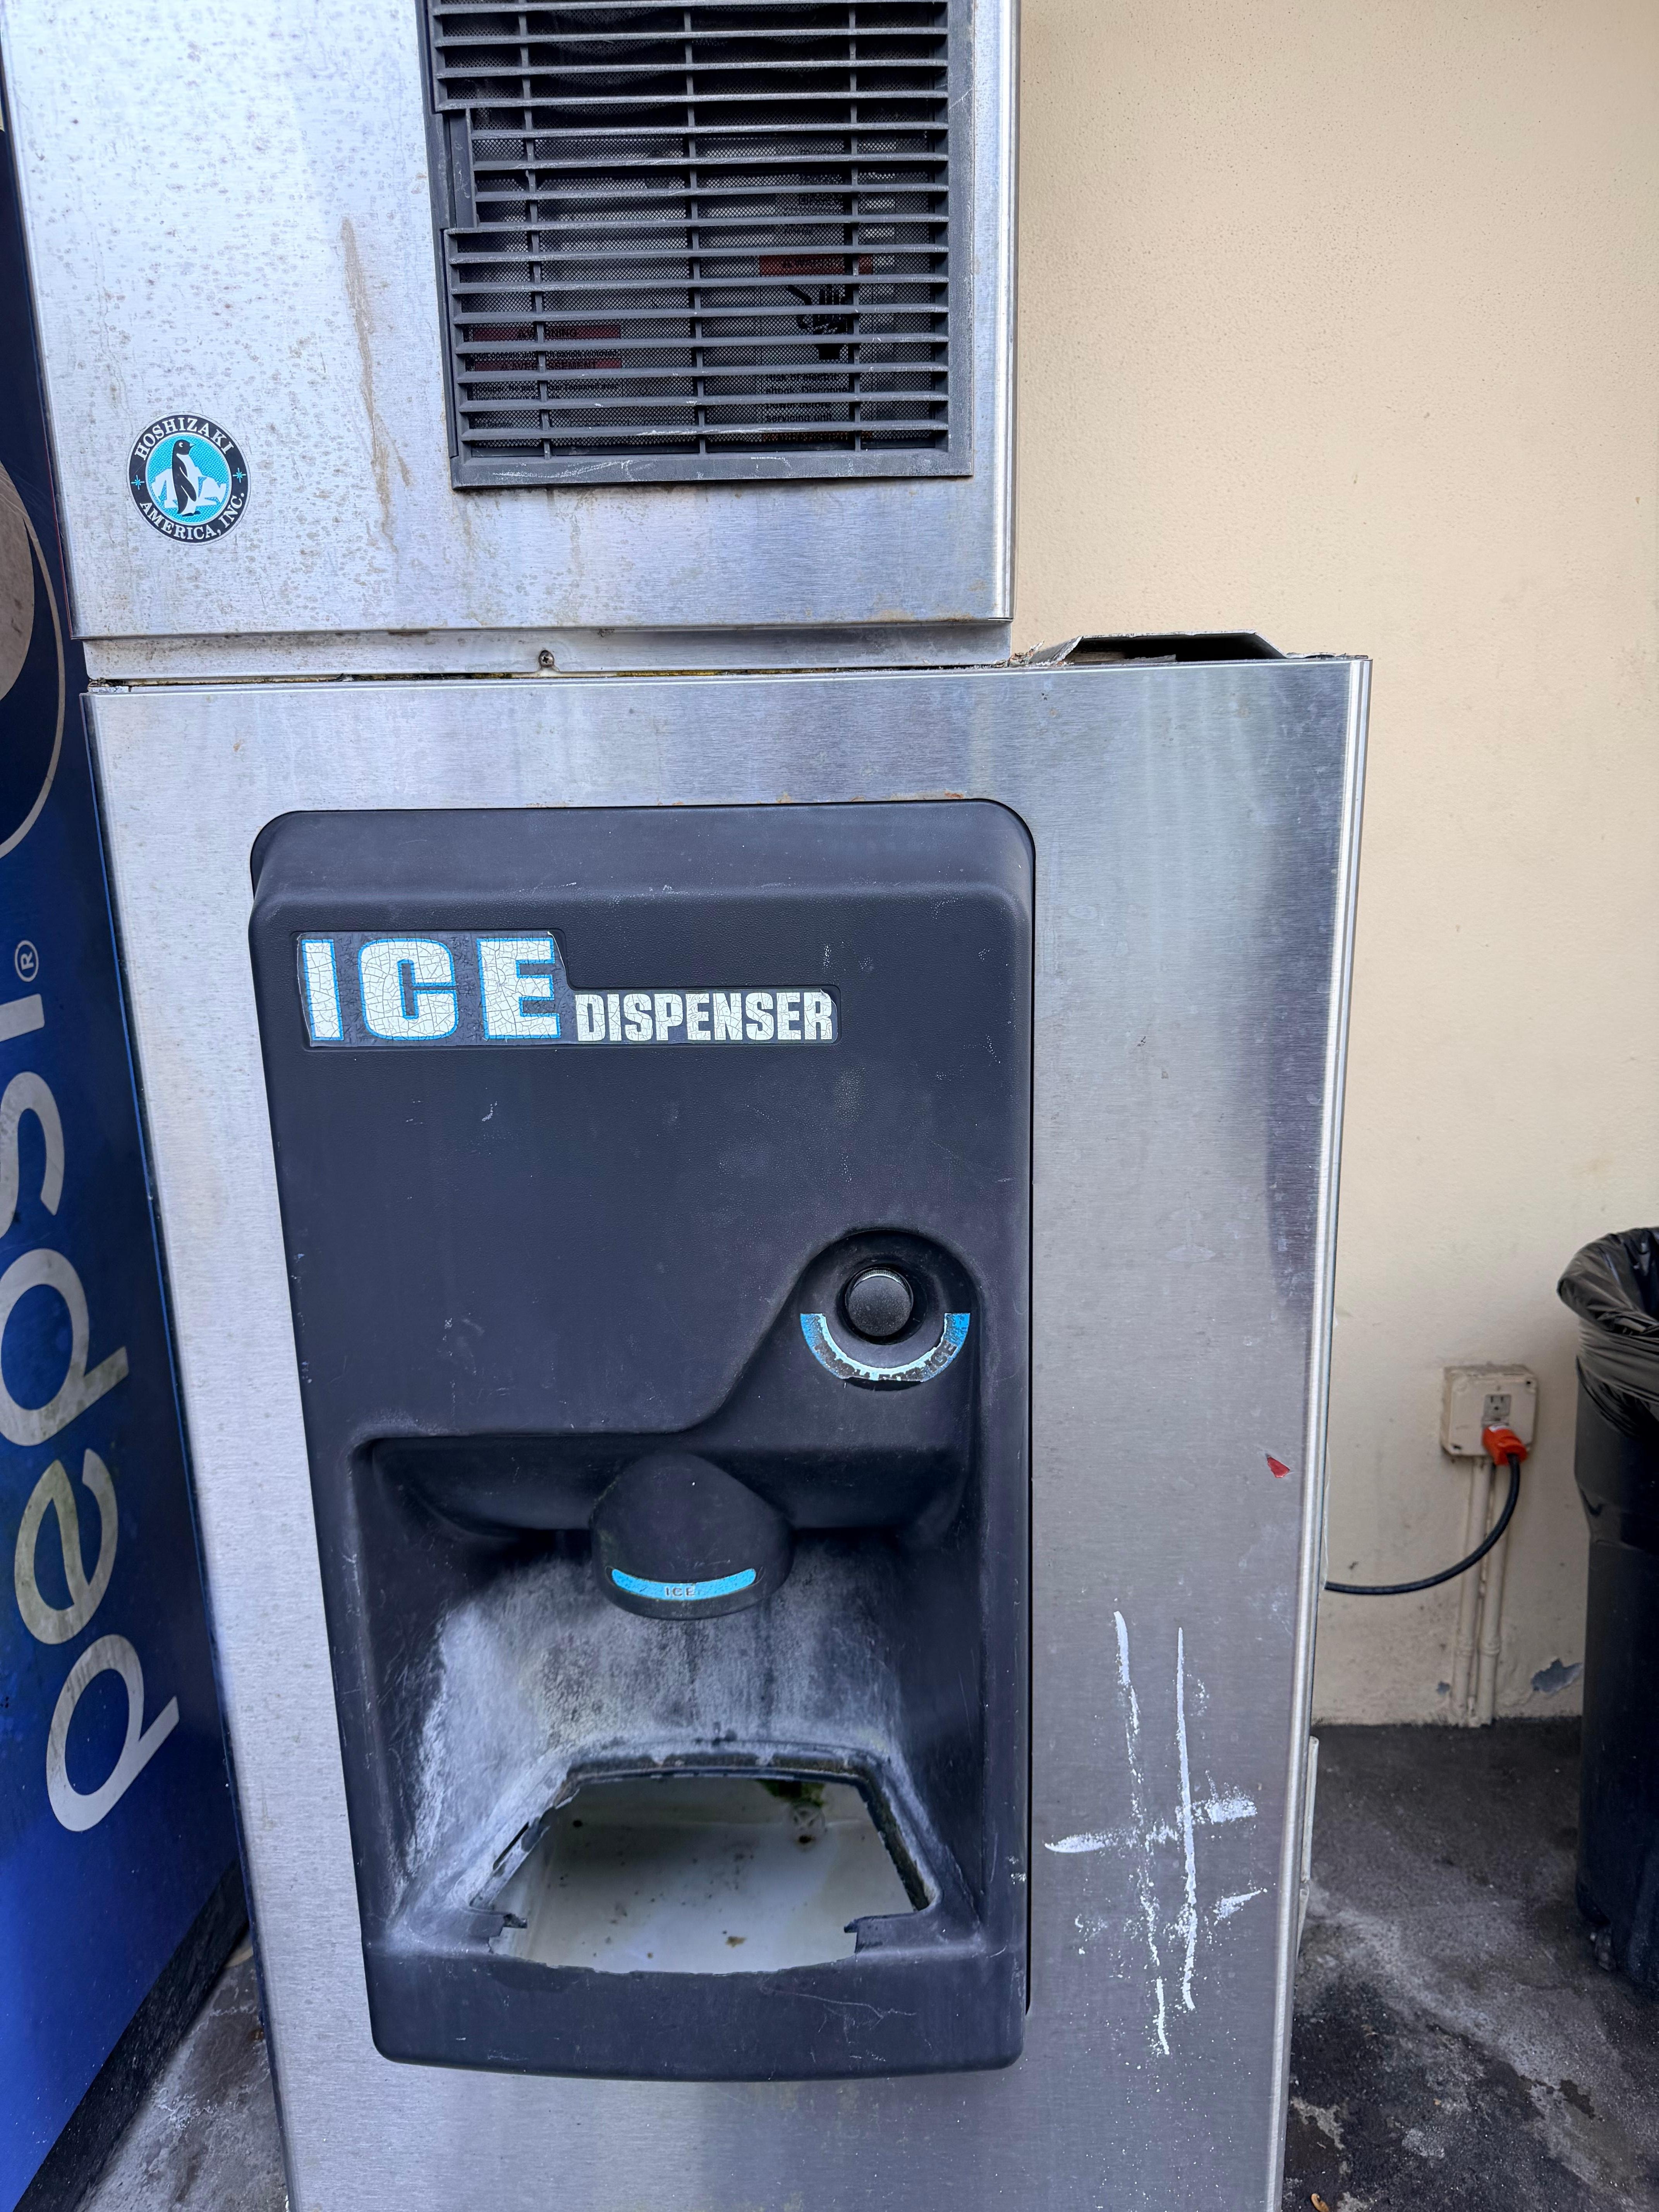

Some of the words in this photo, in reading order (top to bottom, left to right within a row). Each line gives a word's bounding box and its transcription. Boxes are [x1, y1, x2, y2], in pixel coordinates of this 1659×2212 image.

[134, 417, 234, 460] HOSHIZAKI
[139, 502, 222, 540] AMERICA,
[219, 493, 245, 528] INC.
[301, 937, 562, 1041] ICE
[574, 991, 834, 1042] DISPENSER
[666, 1587, 696, 1597] ICE
